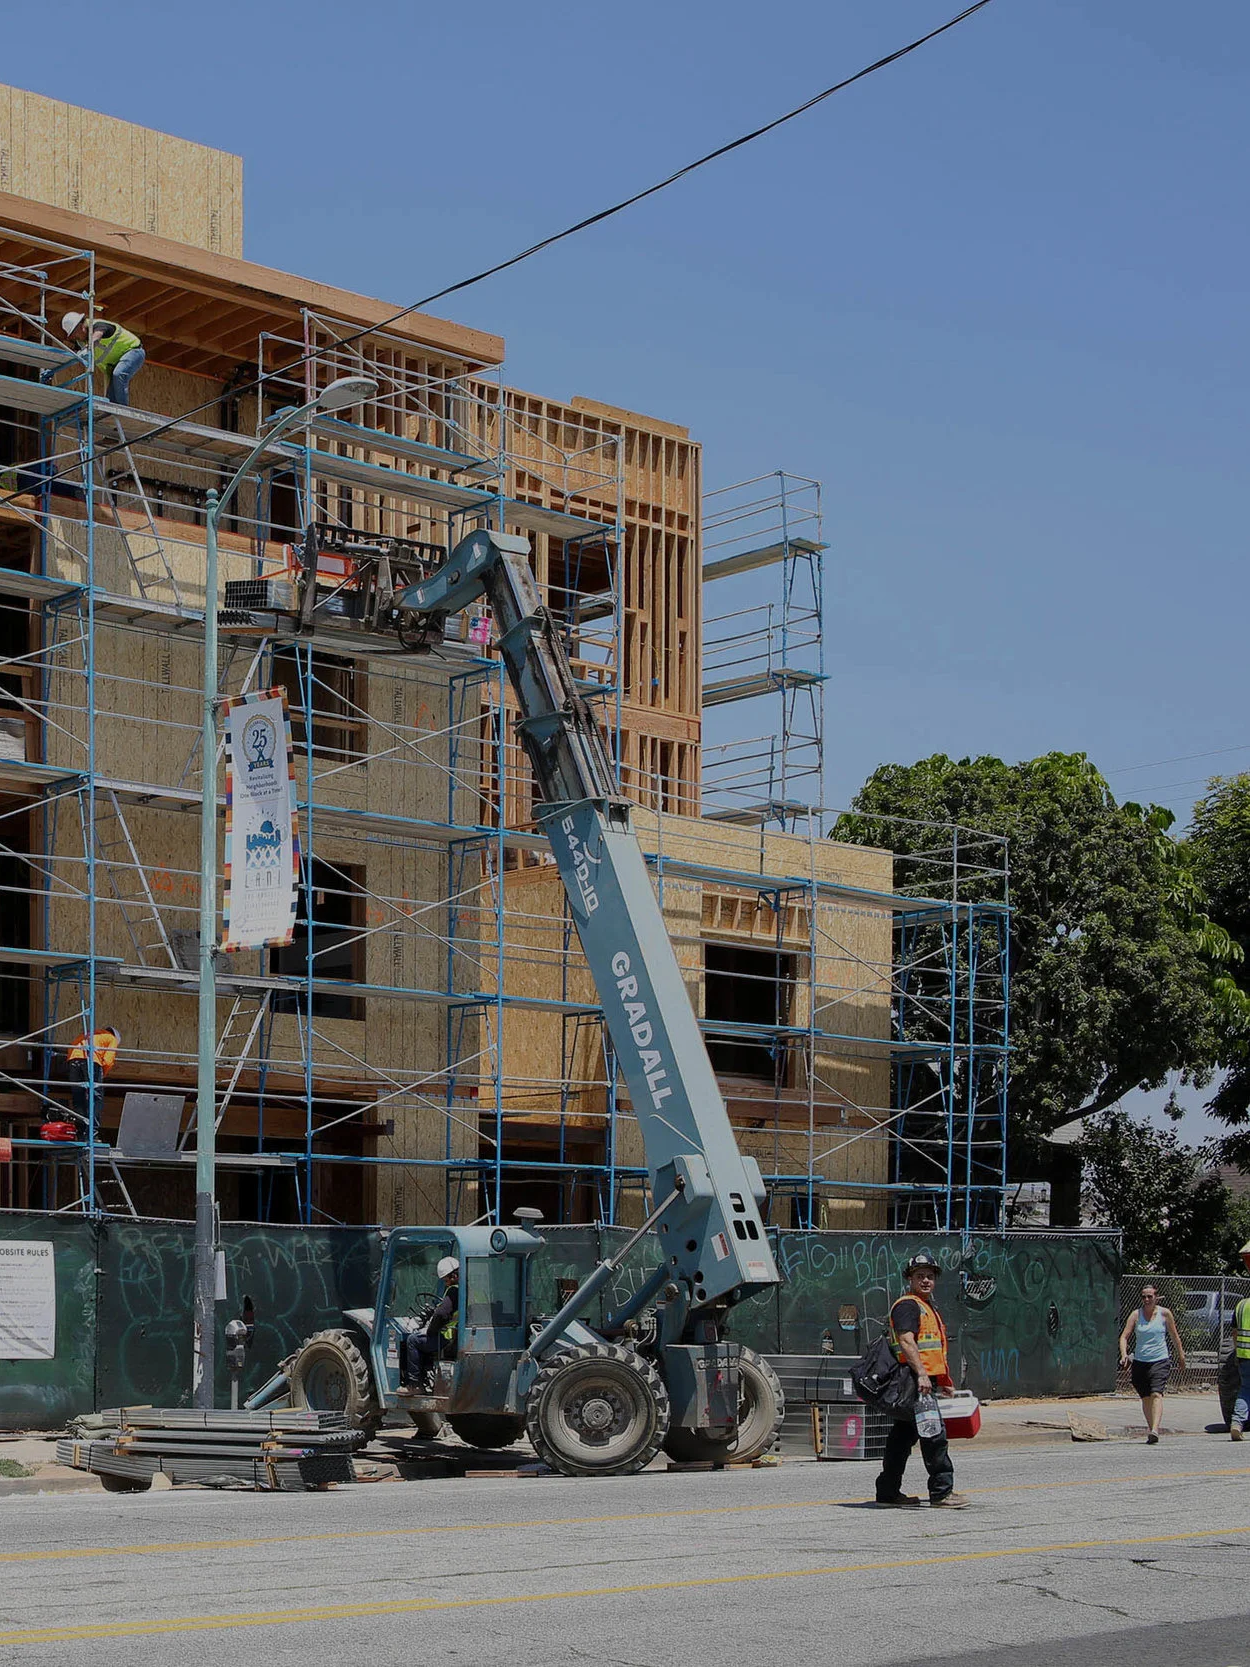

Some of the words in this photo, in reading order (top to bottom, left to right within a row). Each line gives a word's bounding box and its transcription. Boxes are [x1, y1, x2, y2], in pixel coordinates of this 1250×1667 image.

[160, 653, 170, 694] TLLWALL
[252, 728, 267, 749] 25
[611, 951, 672, 1110] GRADALL
[26, 1248, 49, 1256] RULES
